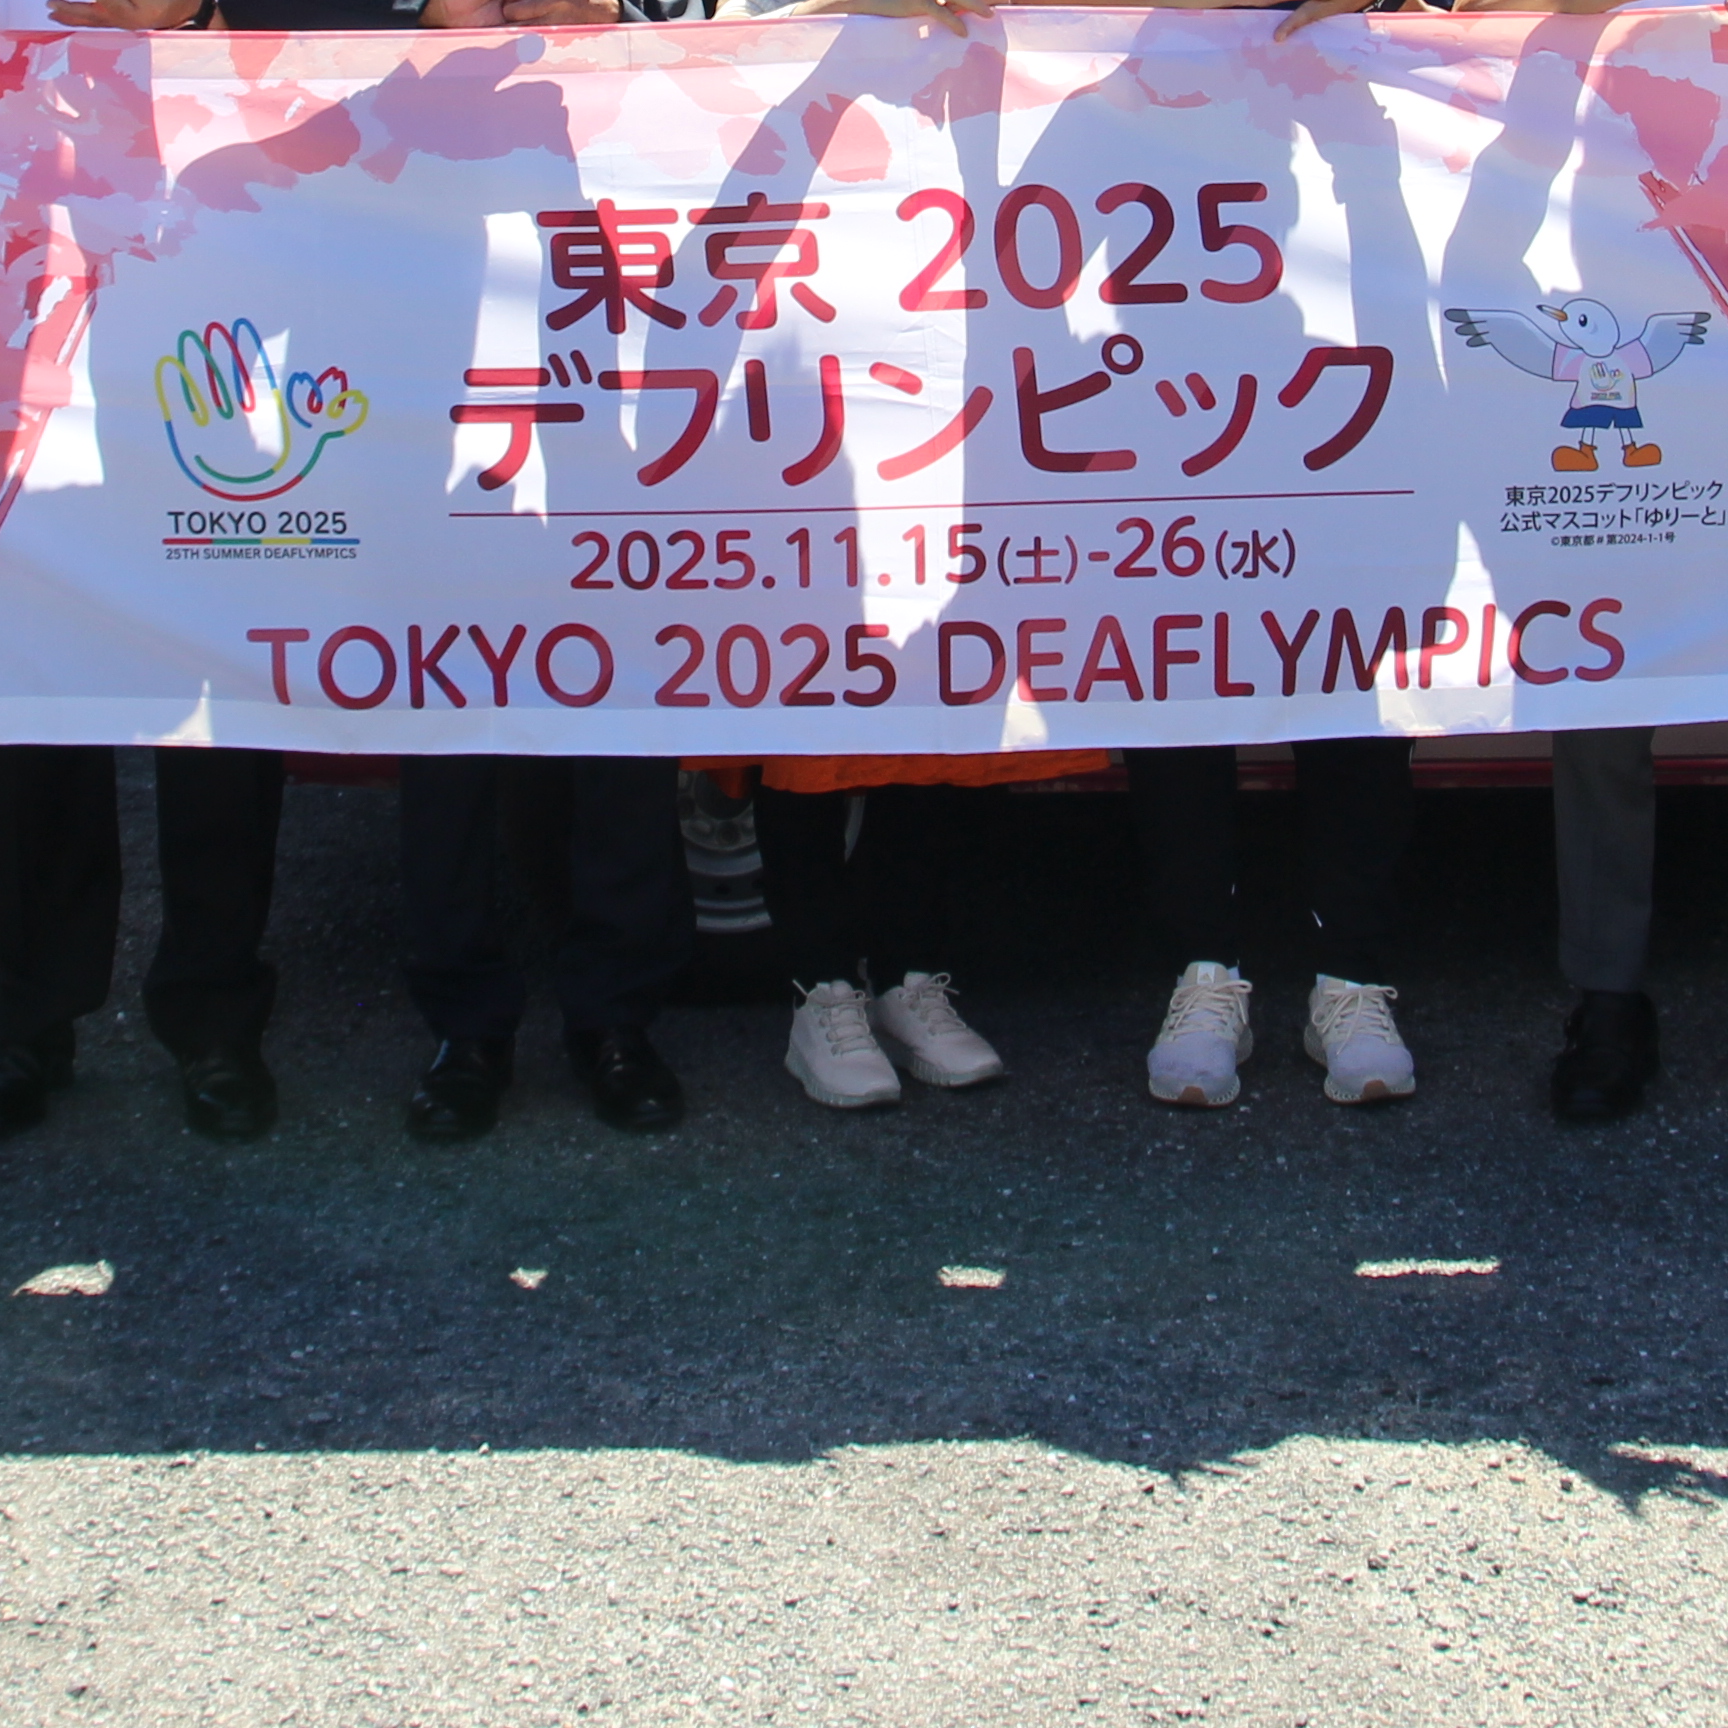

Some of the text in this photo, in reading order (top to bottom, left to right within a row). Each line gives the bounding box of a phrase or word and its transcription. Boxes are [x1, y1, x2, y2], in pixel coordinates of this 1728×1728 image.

[536, 182, 1284, 334] 東京 2025
[449, 332, 1395, 492] デフリンピック
[1505, 479, 1724, 507] 東京2025デフリンピック
[167, 511, 348, 535] TOKYO 2025
[1500, 505, 1727, 533] 公式マスコット「ゆりーと」
[165, 547, 357, 560] 25TH SUMMER DEAFLYMPICS
[246, 597, 1626, 710] TOKYO 2025 DEAFLYMPICS
